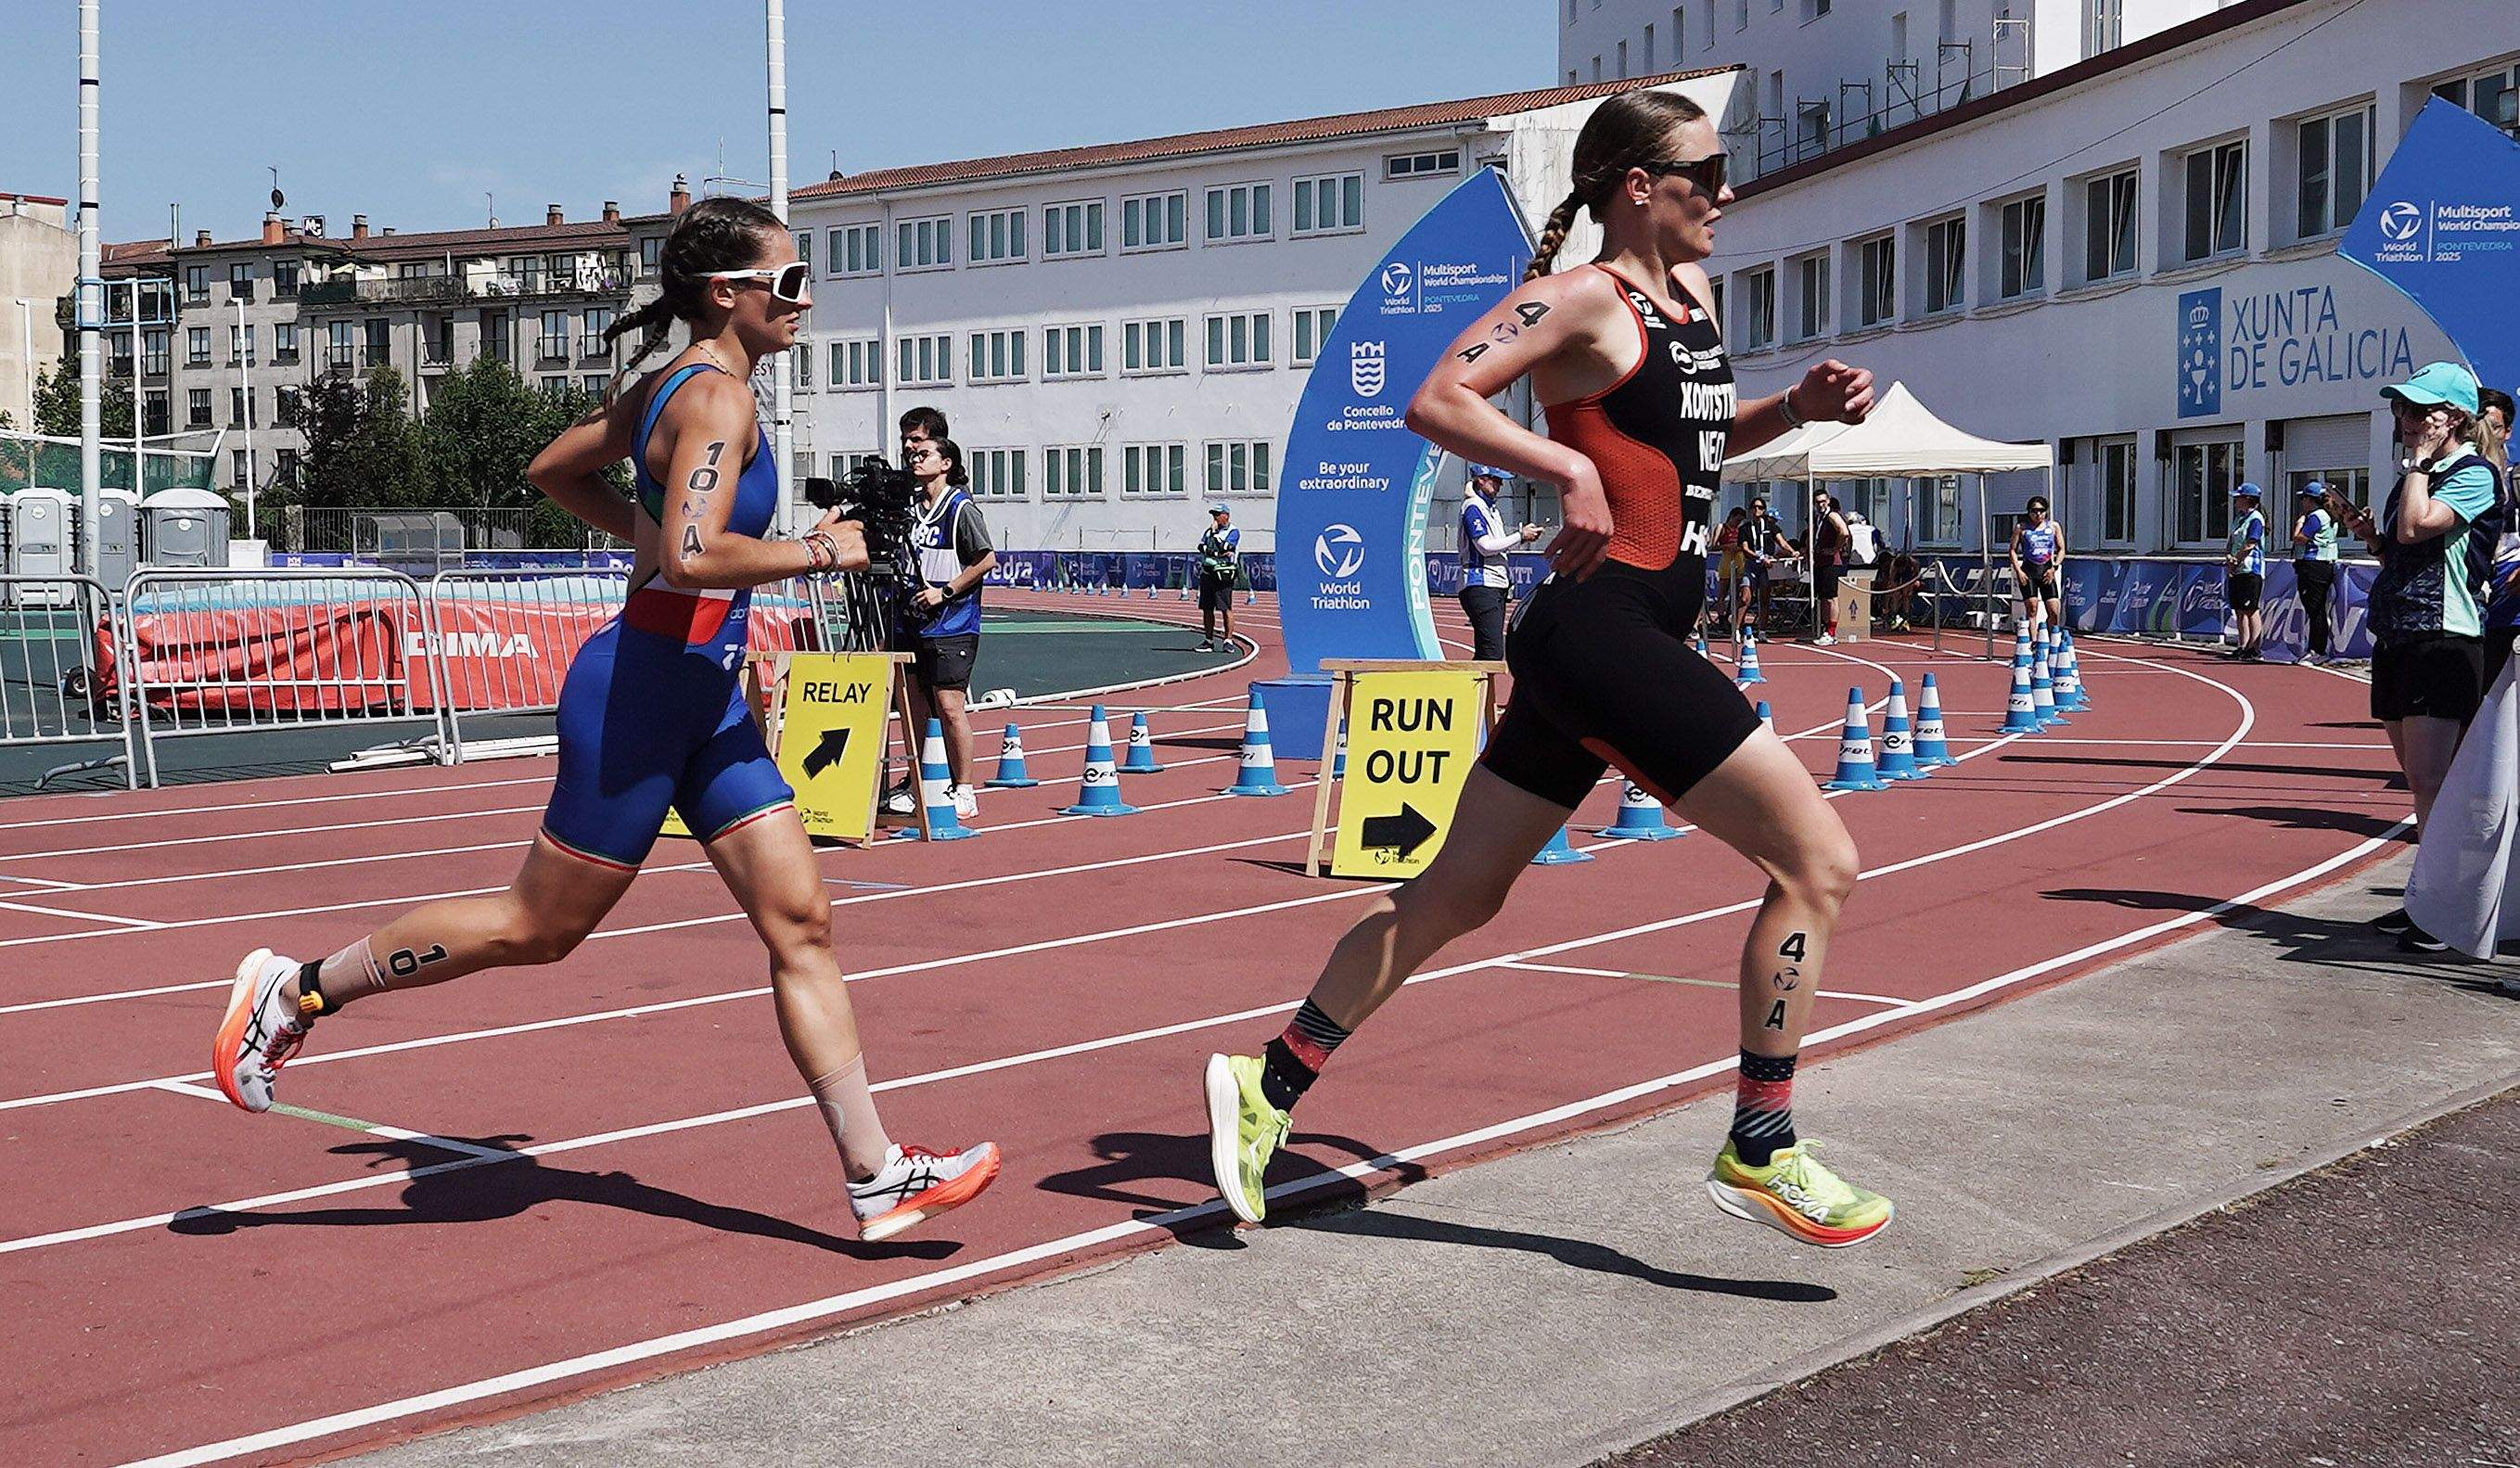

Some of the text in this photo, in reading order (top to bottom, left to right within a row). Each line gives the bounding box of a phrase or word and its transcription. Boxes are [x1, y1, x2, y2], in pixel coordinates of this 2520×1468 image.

[2438, 205, 2513, 220] Multisport
[2438, 220, 2471, 231] World
[2383, 242, 2417, 251] World
[2437, 242, 2513, 250] PONTEVEDRA
[2374, 252, 2423, 262] Triathlon
[2436, 251, 2462, 261] 2025
[1424, 263, 1477, 276] Multisport
[1425, 274, 1508, 287] World Championships
[1385, 296, 1410, 305] World
[1380, 306, 1414, 314] Triathlon
[1424, 304, 1442, 313] 2025
[1515, 301, 1551, 327] 4
[2232, 285, 2339, 343] XUNTA
[1456, 342, 1490, 364] A
[2231, 326, 2413, 390] DE GALICIA
[1343, 405, 1394, 417] Concello
[1327, 417, 1407, 431] de Pontevedr
[1320, 462, 1370, 476] Be your
[1299, 476, 1389, 491] extraordinary
[681, 523, 706, 562] A
[984, 555, 1032, 581] edra
[1320, 581, 1361, 594] World
[1311, 596, 1370, 609] Triathlon
[802, 682, 872, 703] RELAY
[1371, 697, 1452, 732] RUN
[1366, 749, 1450, 784] OUT
[1778, 931, 1807, 964] 4
[1764, 998, 1787, 1031] A
[1766, 1173, 1831, 1224] HOKA
